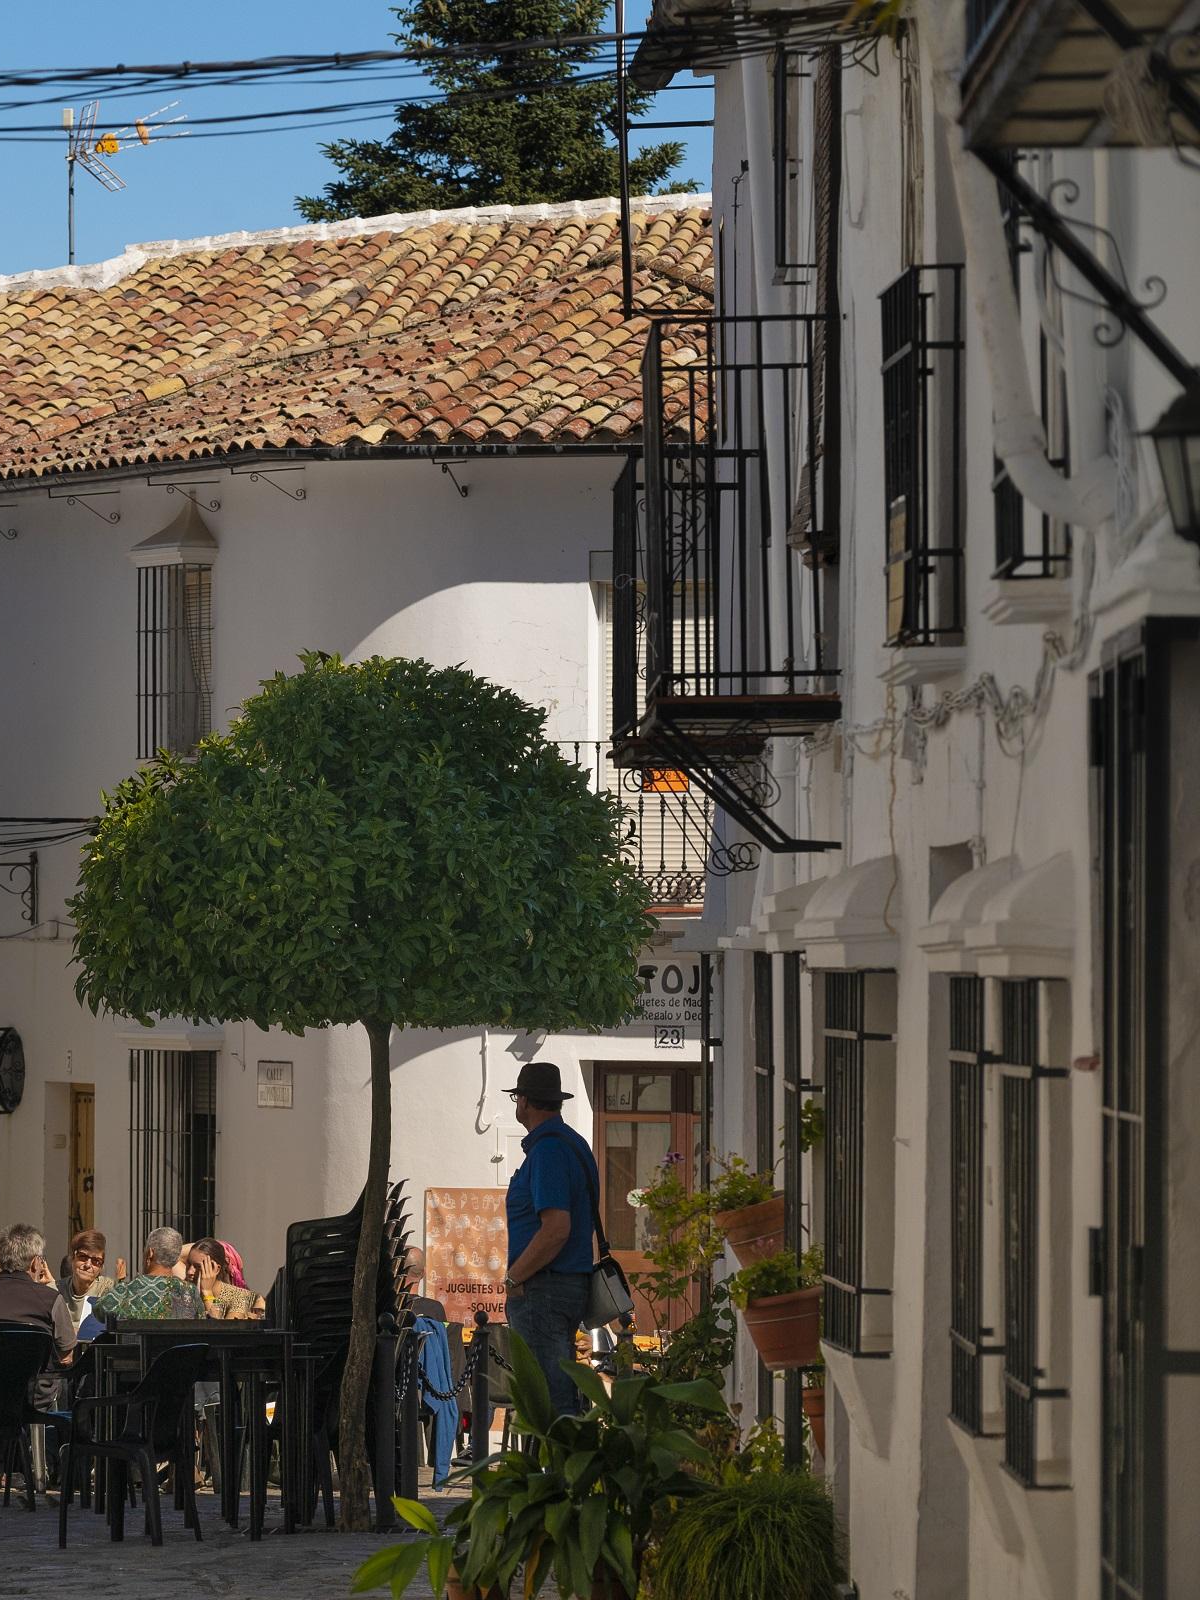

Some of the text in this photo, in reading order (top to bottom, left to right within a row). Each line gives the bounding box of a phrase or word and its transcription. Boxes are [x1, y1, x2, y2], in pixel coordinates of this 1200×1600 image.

[639, 964, 714, 994] TOJ
[669, 997, 680, 1007] de
[676, 1012, 682, 1021] y
[658, 1028, 680, 1044] 23
[445, 1283, 493, 1294] JUGUETES
[496, 1284, 505, 1294] D
[467, 1302, 504, 1313] -SOUVE
